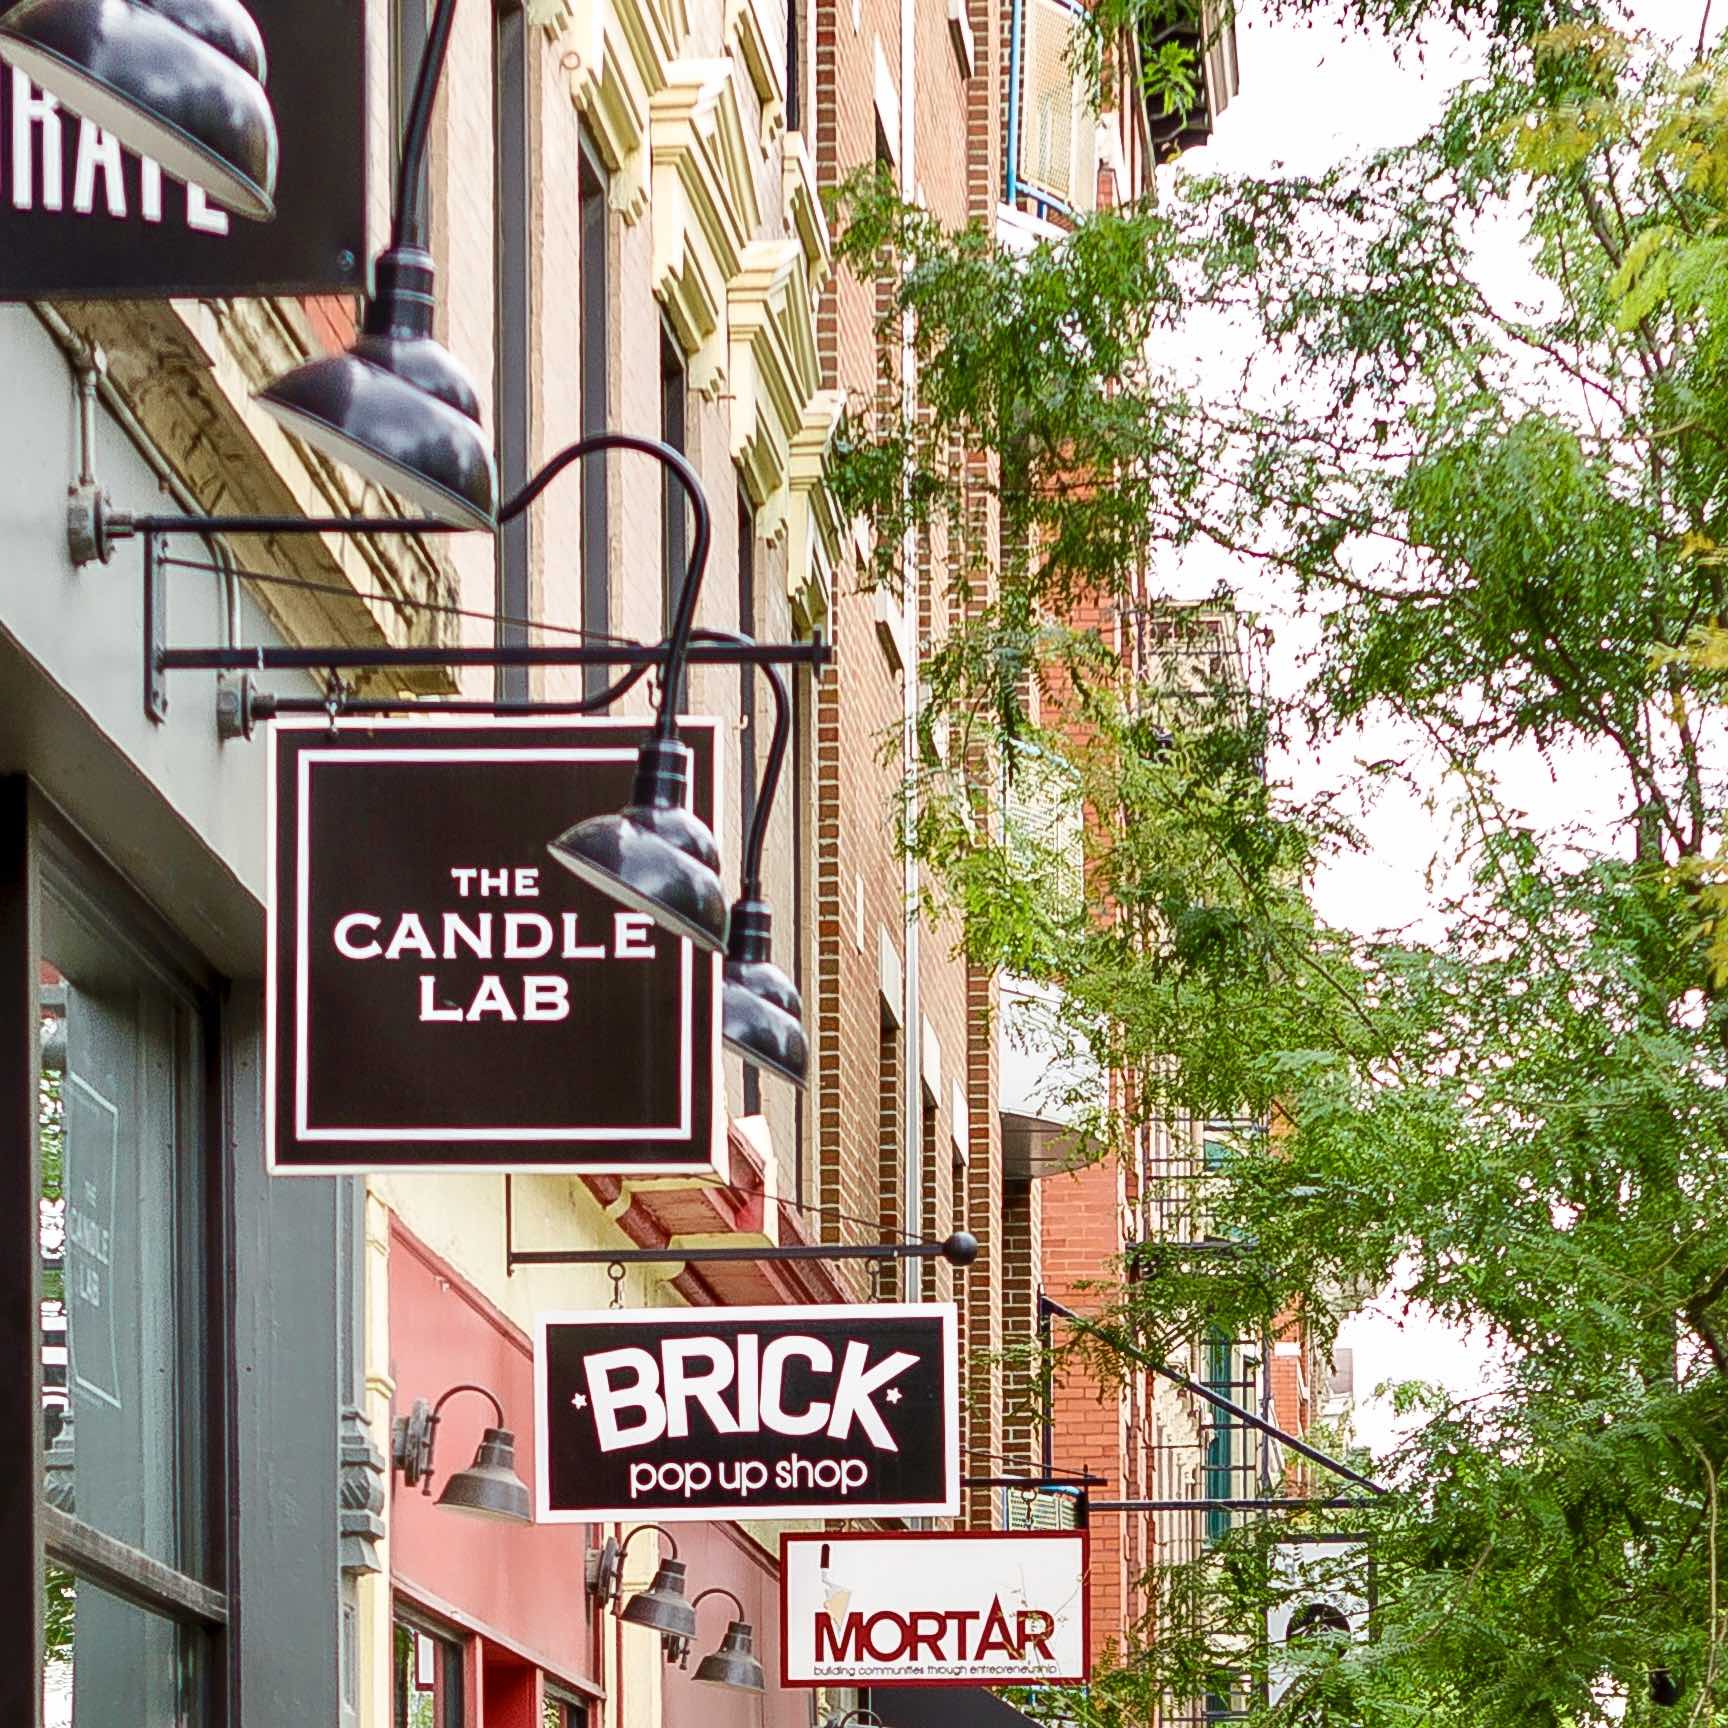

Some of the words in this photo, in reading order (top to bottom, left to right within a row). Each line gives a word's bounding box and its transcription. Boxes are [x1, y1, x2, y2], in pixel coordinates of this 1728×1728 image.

[451, 867, 540, 897] THE
[333, 911, 657, 960] CANDLE
[418, 974, 571, 1022] LAB
[583, 1333, 921, 1453] BRICK
[630, 1460, 712, 1498] pop
[718, 1460, 769, 1497] up
[775, 1453, 869, 1495] shop
[814, 1592, 1055, 1662] MORTAR
[813, 1665, 856, 1677] building
[858, 1664, 925, 1676] communities
[927, 1664, 968, 1676] through
